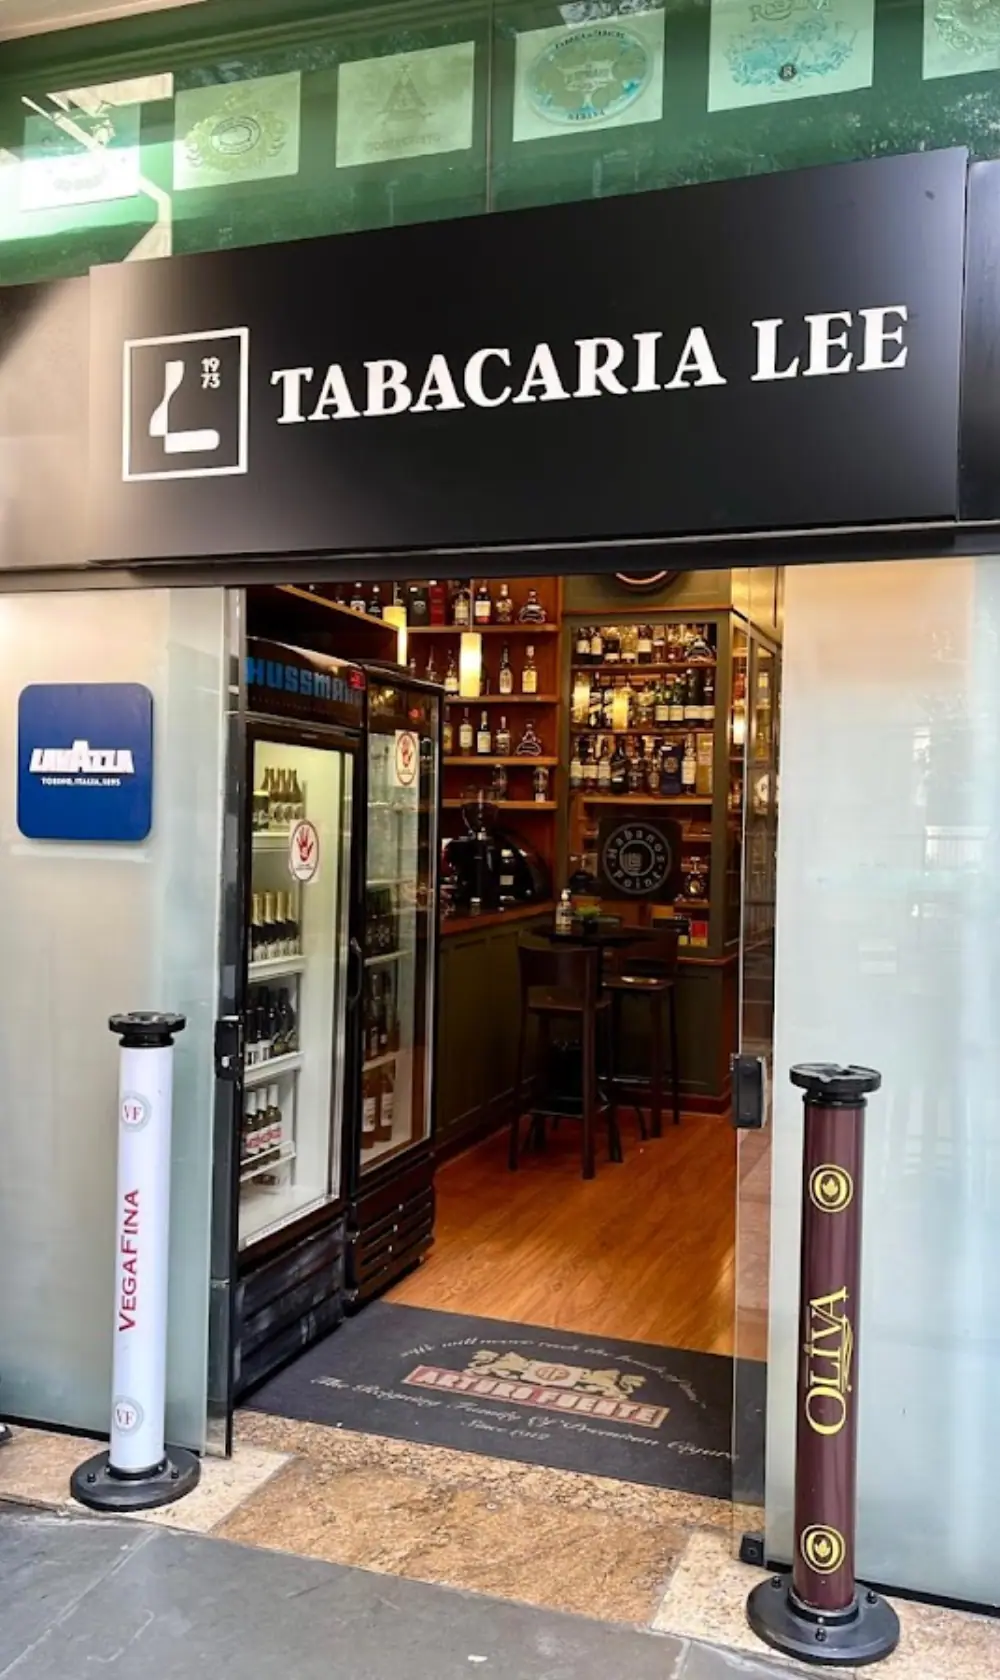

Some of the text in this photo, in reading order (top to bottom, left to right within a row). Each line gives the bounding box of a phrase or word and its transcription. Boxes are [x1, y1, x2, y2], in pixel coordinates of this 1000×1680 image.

[201, 356, 221, 373] 19
[201, 372, 221, 389] 73
[270, 305, 909, 424] TABACARIA LEE
[29, 740, 135, 774] LAVAZZA
[607, 829, 665, 862] Habanos
[612, 869, 661, 889] Point
[415, 1370, 534, 1400] ARTURO
[536, 1390, 657, 1423] FUENTE
